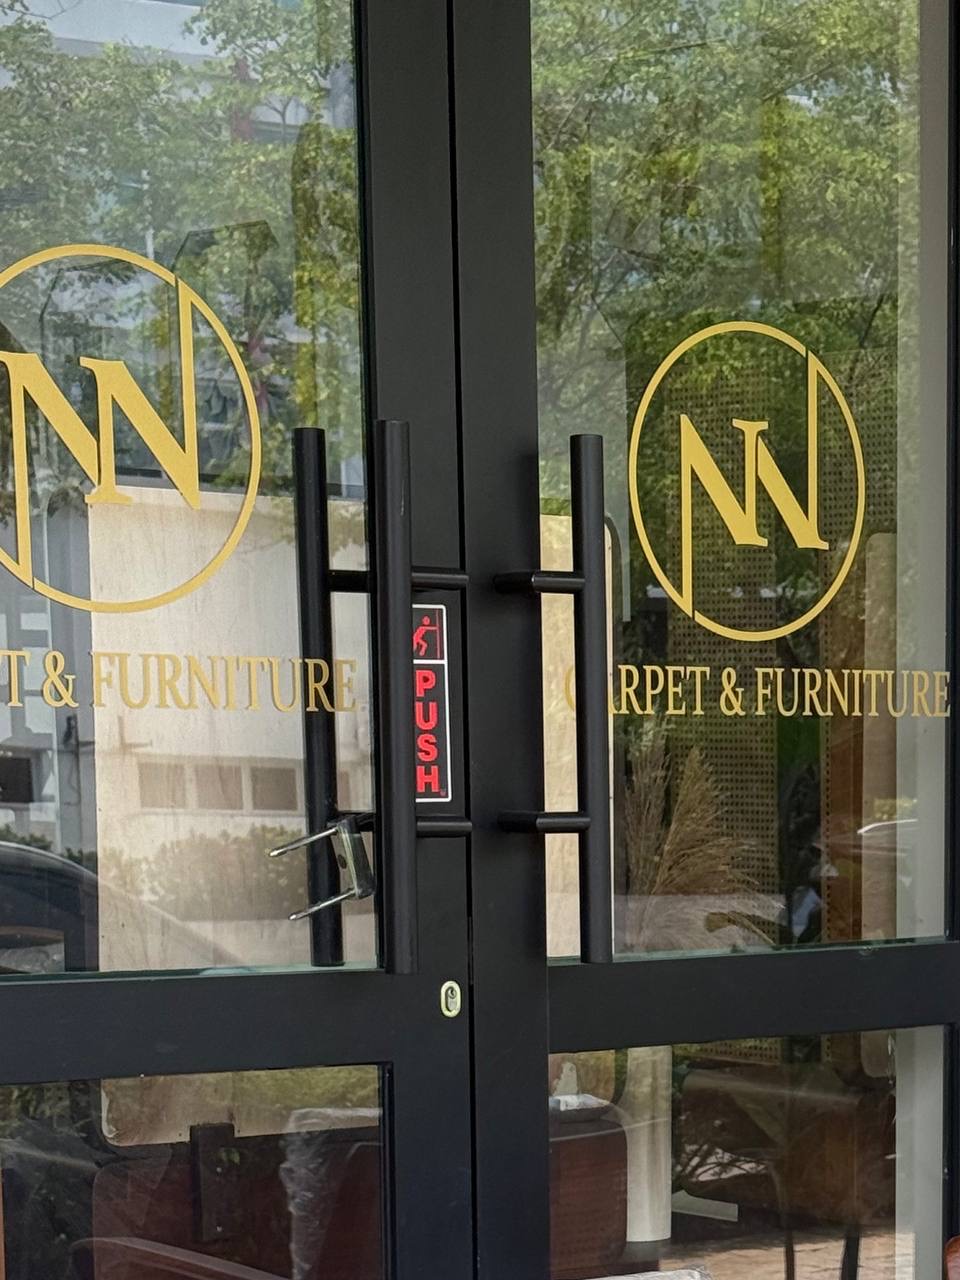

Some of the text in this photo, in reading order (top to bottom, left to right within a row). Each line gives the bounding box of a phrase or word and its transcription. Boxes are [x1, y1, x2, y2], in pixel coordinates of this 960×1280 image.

[43, 650, 80, 708] &
[91, 650, 361, 712] FURNITURE
[719, 666, 746, 717] &
[755, 666, 951, 718] FURNITURE
[415, 669, 440, 793] PUSH
